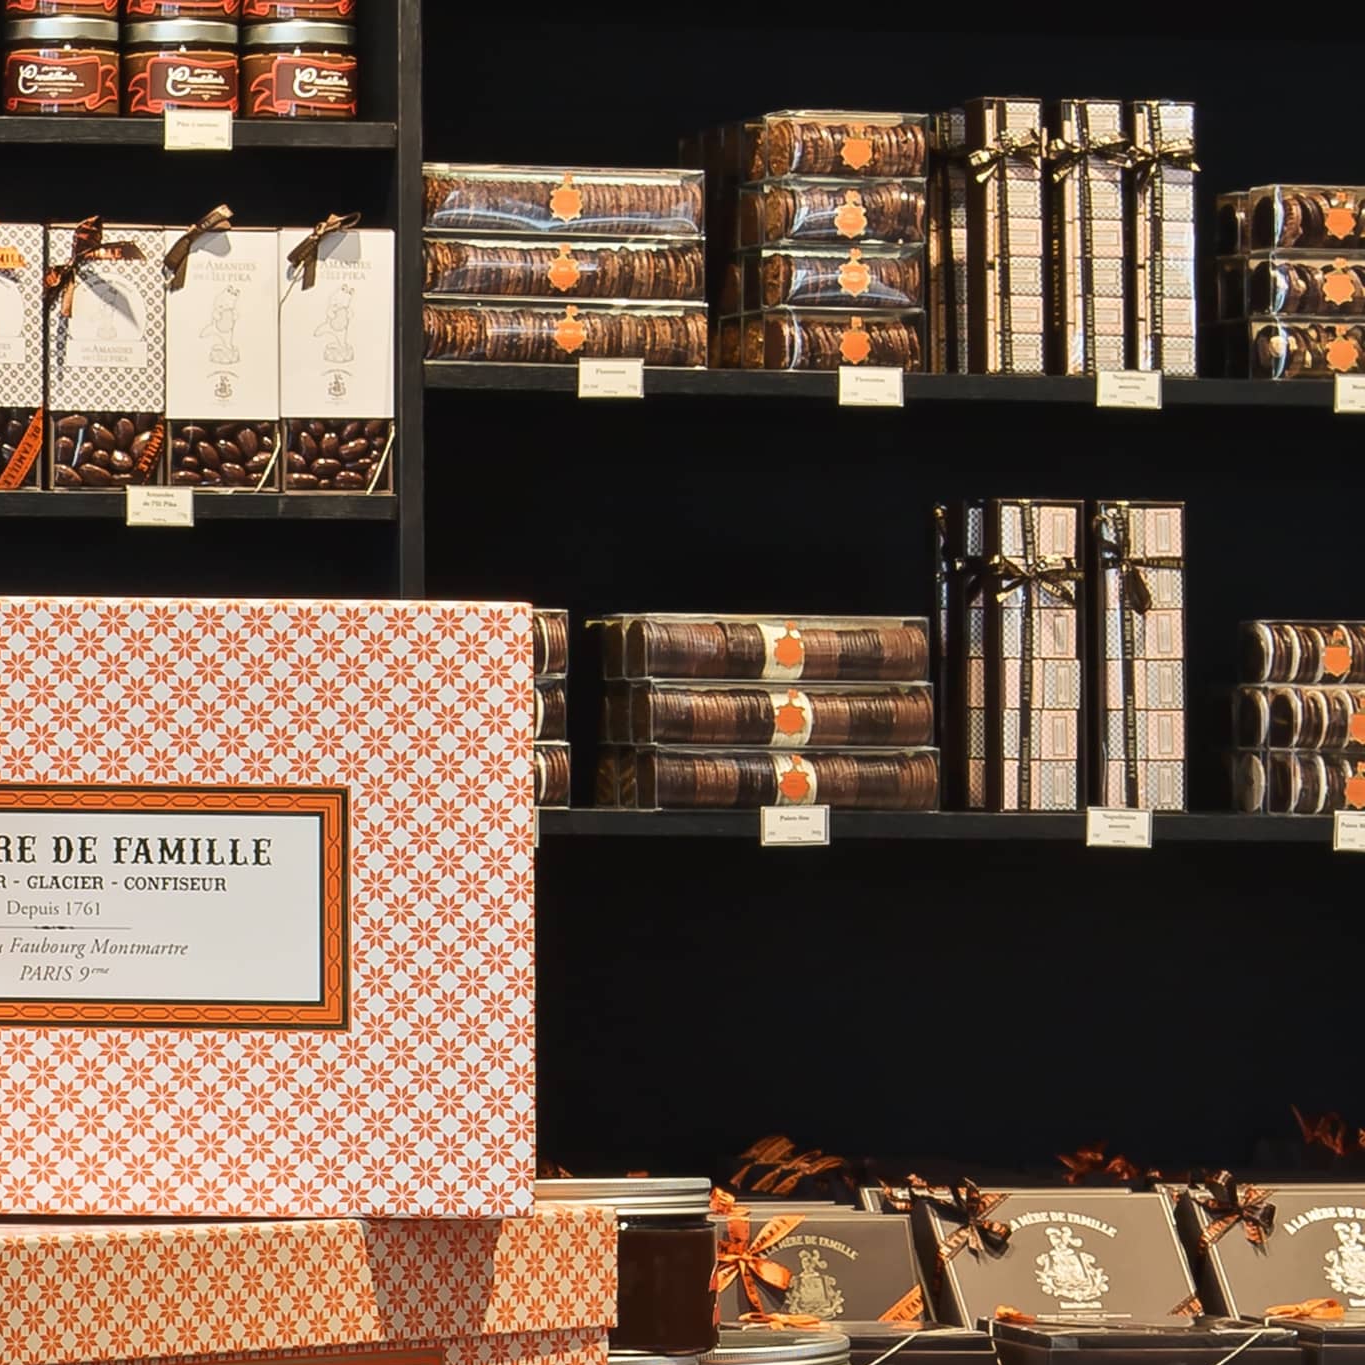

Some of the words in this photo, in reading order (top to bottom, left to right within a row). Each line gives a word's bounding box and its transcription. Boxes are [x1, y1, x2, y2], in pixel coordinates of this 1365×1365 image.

[52, 835, 98, 864] DE
[113, 836, 273, 867] FAMILLE
[27, 875, 104, 891] GLACIER
[124, 876, 228, 892] CONFISEUR
[6, 900, 60, 920] Depuis
[66, 901, 101, 917] 1761
[9, 938, 86, 960] Faubourg
[91, 939, 189, 957] Montmartre
[19, 965, 73, 981] PARIS
[1022, 1211, 1050, 1229] MÈRE
[1051, 1211, 1065, 1223] DE
[1067, 1212, 1118, 1240] FAMILLE
[1295, 1213, 1309, 1231] LA
[1307, 1205, 1335, 1223] MÈRE
[1337, 1205, 1351, 1219] DE
